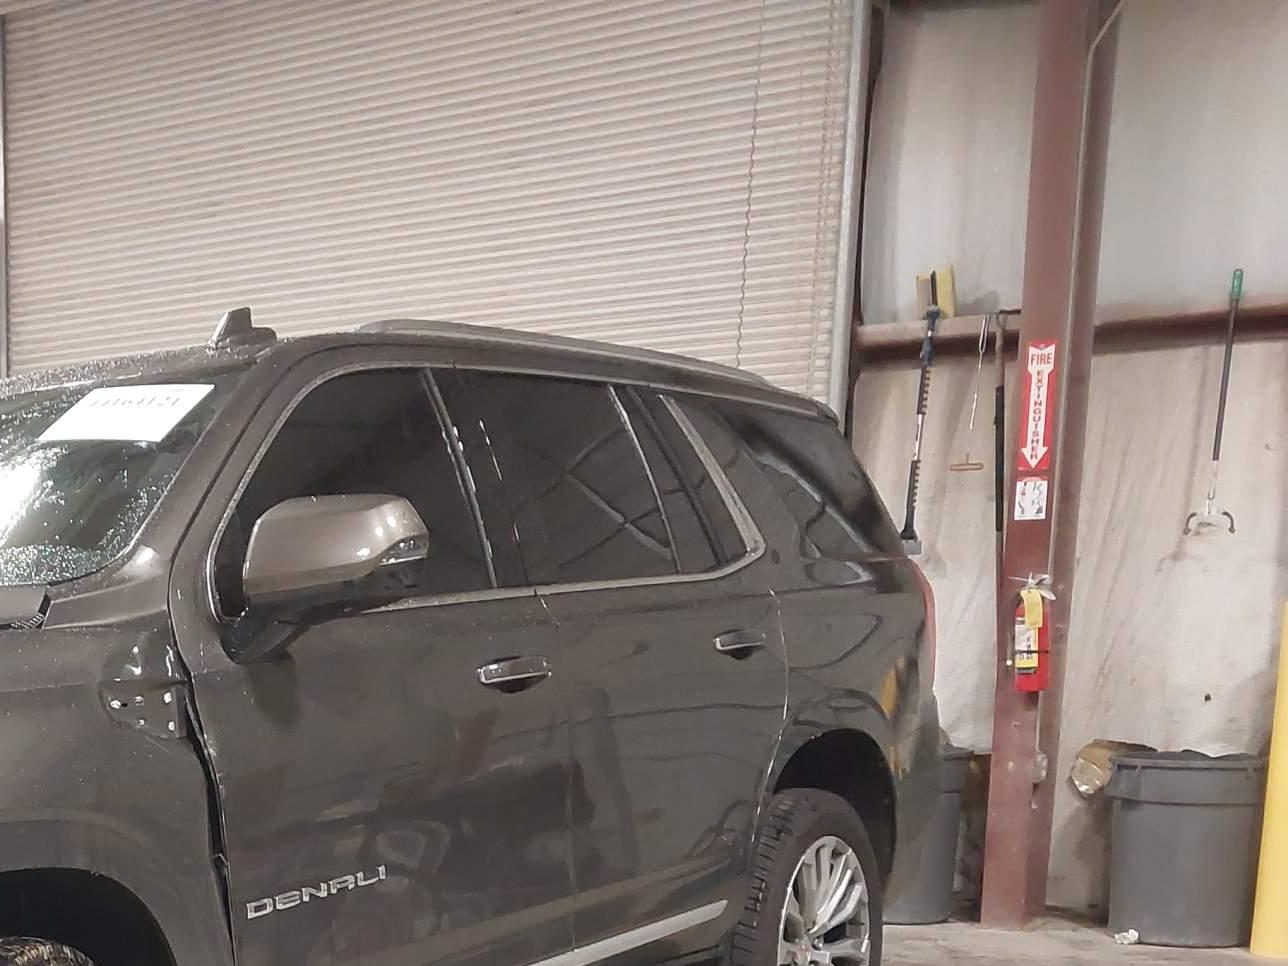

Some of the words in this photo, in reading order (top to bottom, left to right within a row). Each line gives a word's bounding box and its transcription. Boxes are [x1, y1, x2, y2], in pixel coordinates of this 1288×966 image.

[1030, 352, 1053, 366] FIRE
[1030, 369, 1044, 459] EXTINGUISHER
[246, 864, 387, 920] DENALI
